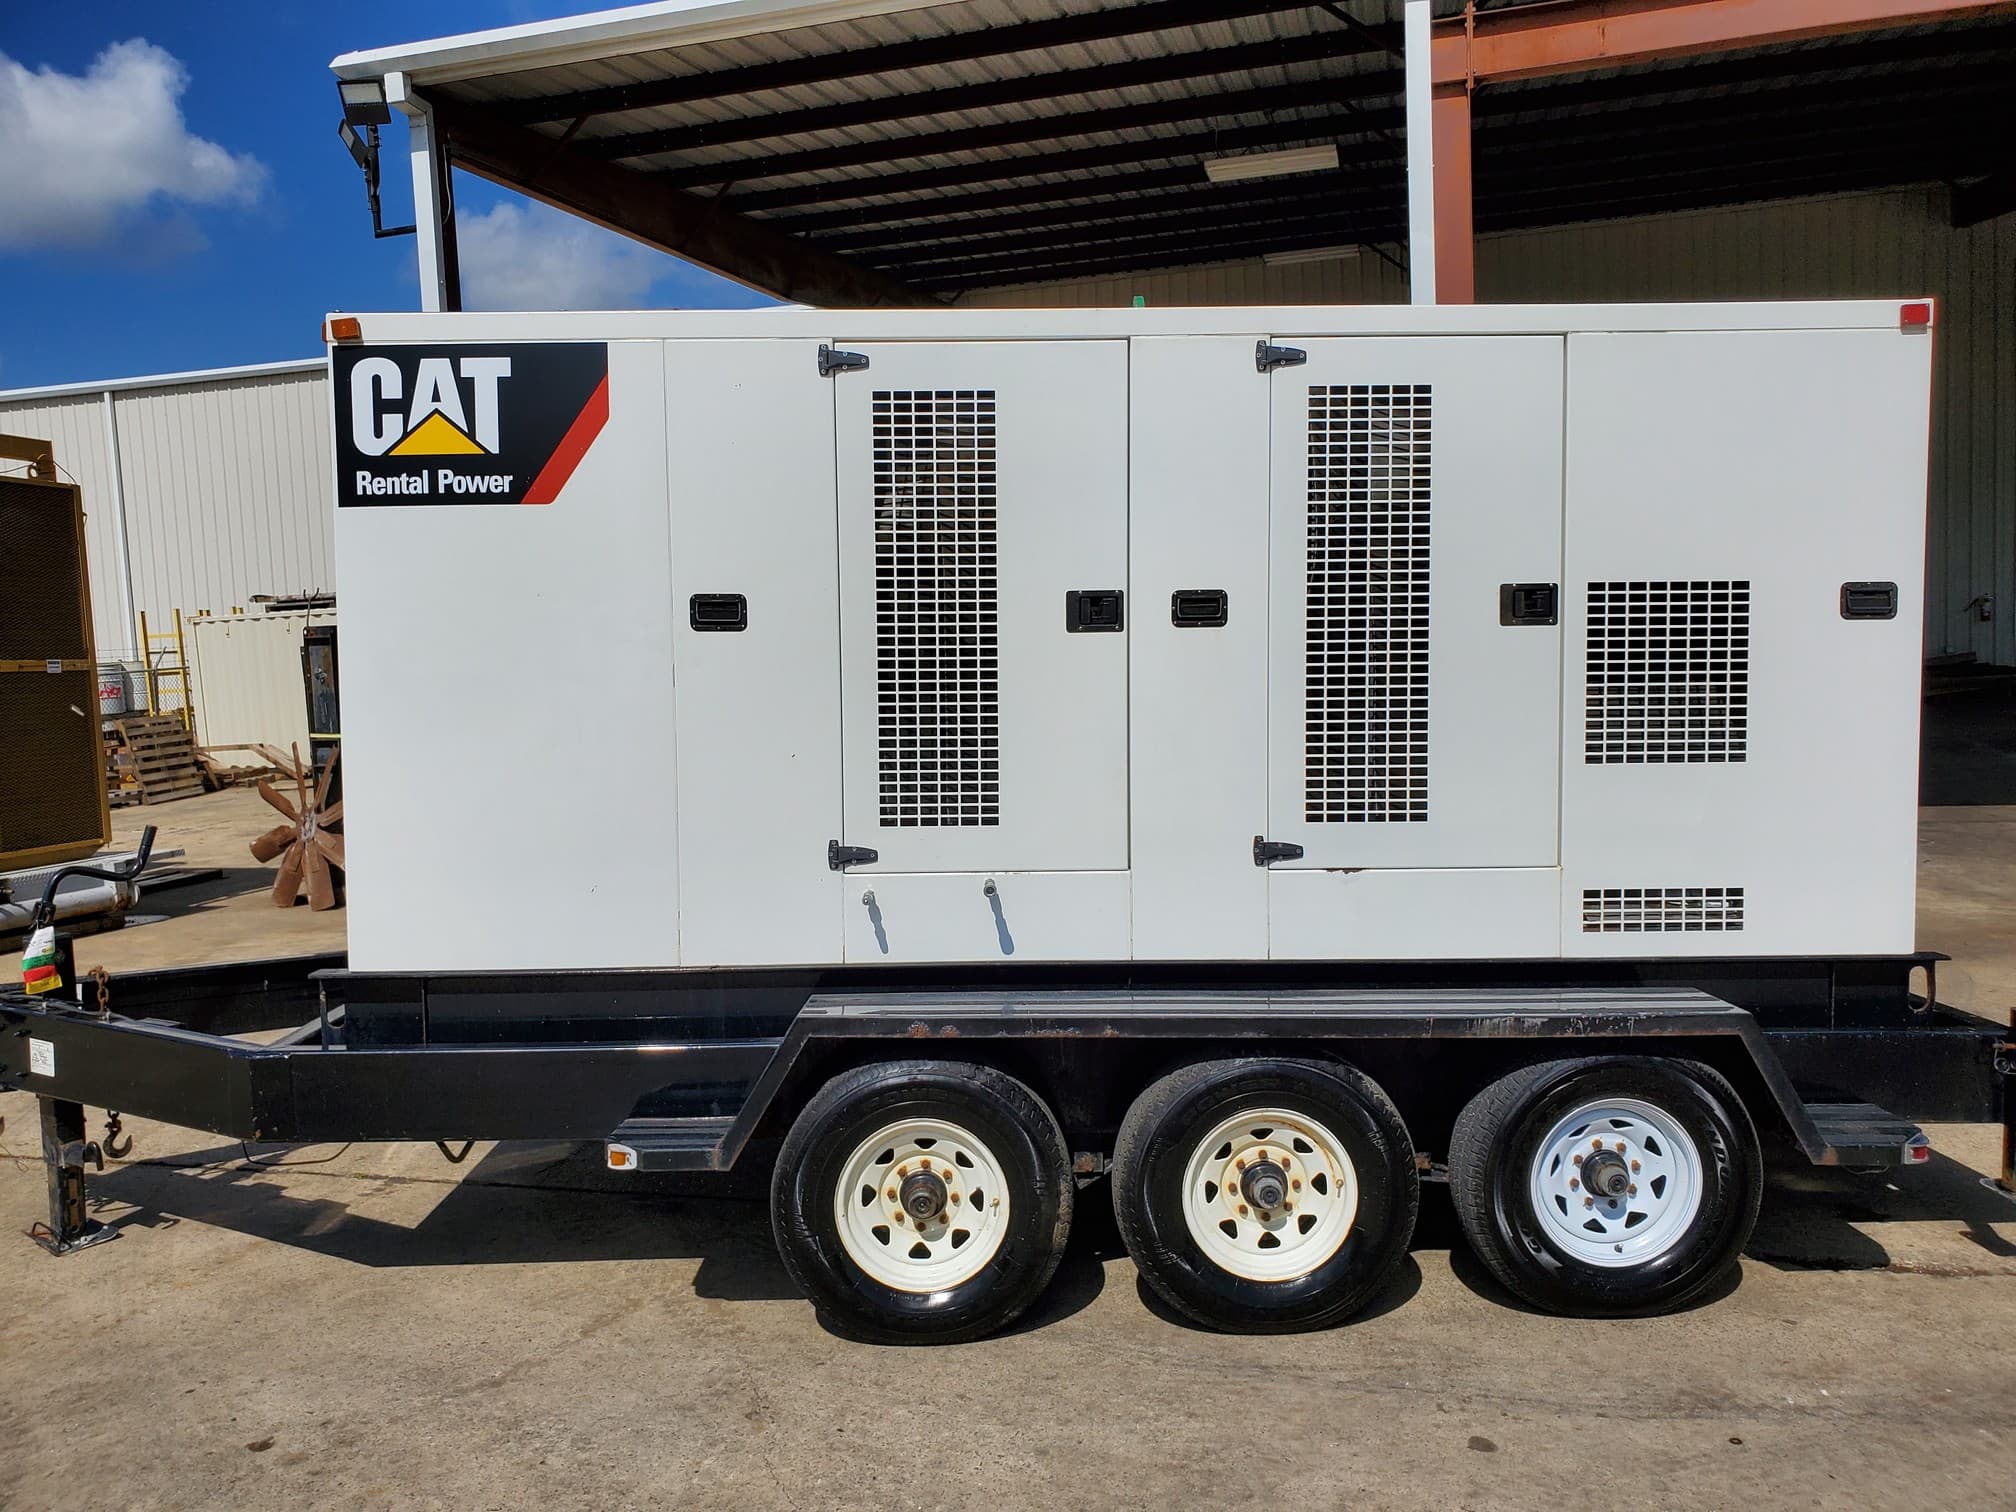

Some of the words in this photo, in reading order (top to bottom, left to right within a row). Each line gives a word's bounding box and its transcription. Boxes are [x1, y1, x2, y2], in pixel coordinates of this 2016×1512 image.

[351, 357, 511, 456] CAT
[356, 469, 429, 496] Rental
[438, 469, 513, 495] Power
